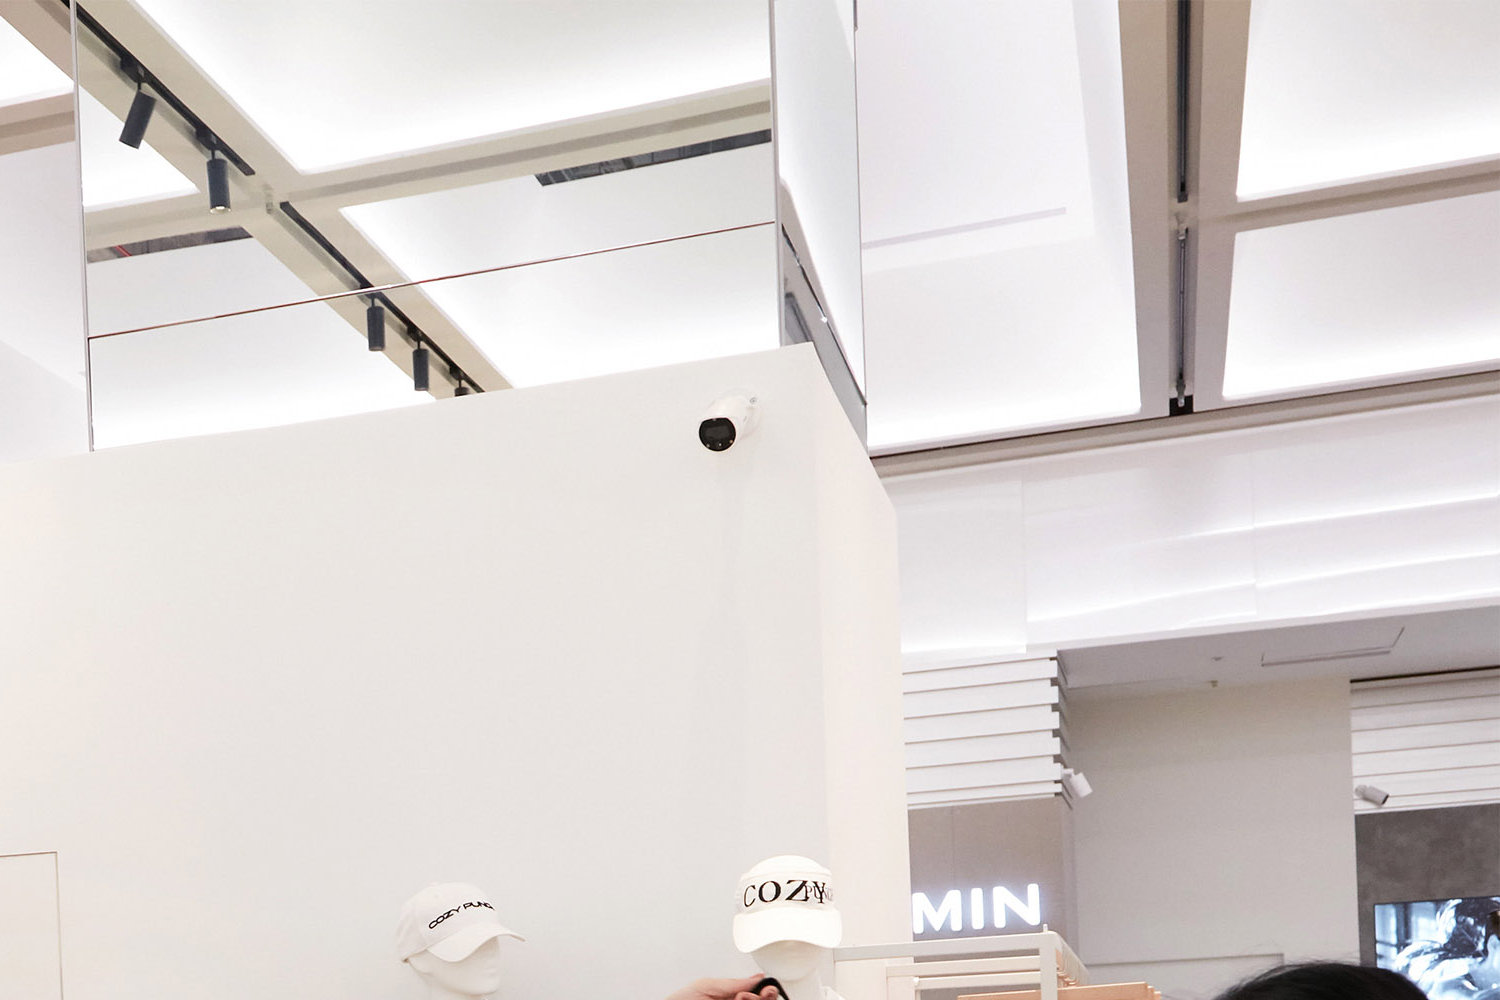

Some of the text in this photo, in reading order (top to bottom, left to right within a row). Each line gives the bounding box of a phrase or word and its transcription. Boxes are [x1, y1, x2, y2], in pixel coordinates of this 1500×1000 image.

[743, 879, 826, 907] COZY
[428, 905, 461, 929] COZY
[911, 883, 1041, 934] MIN
